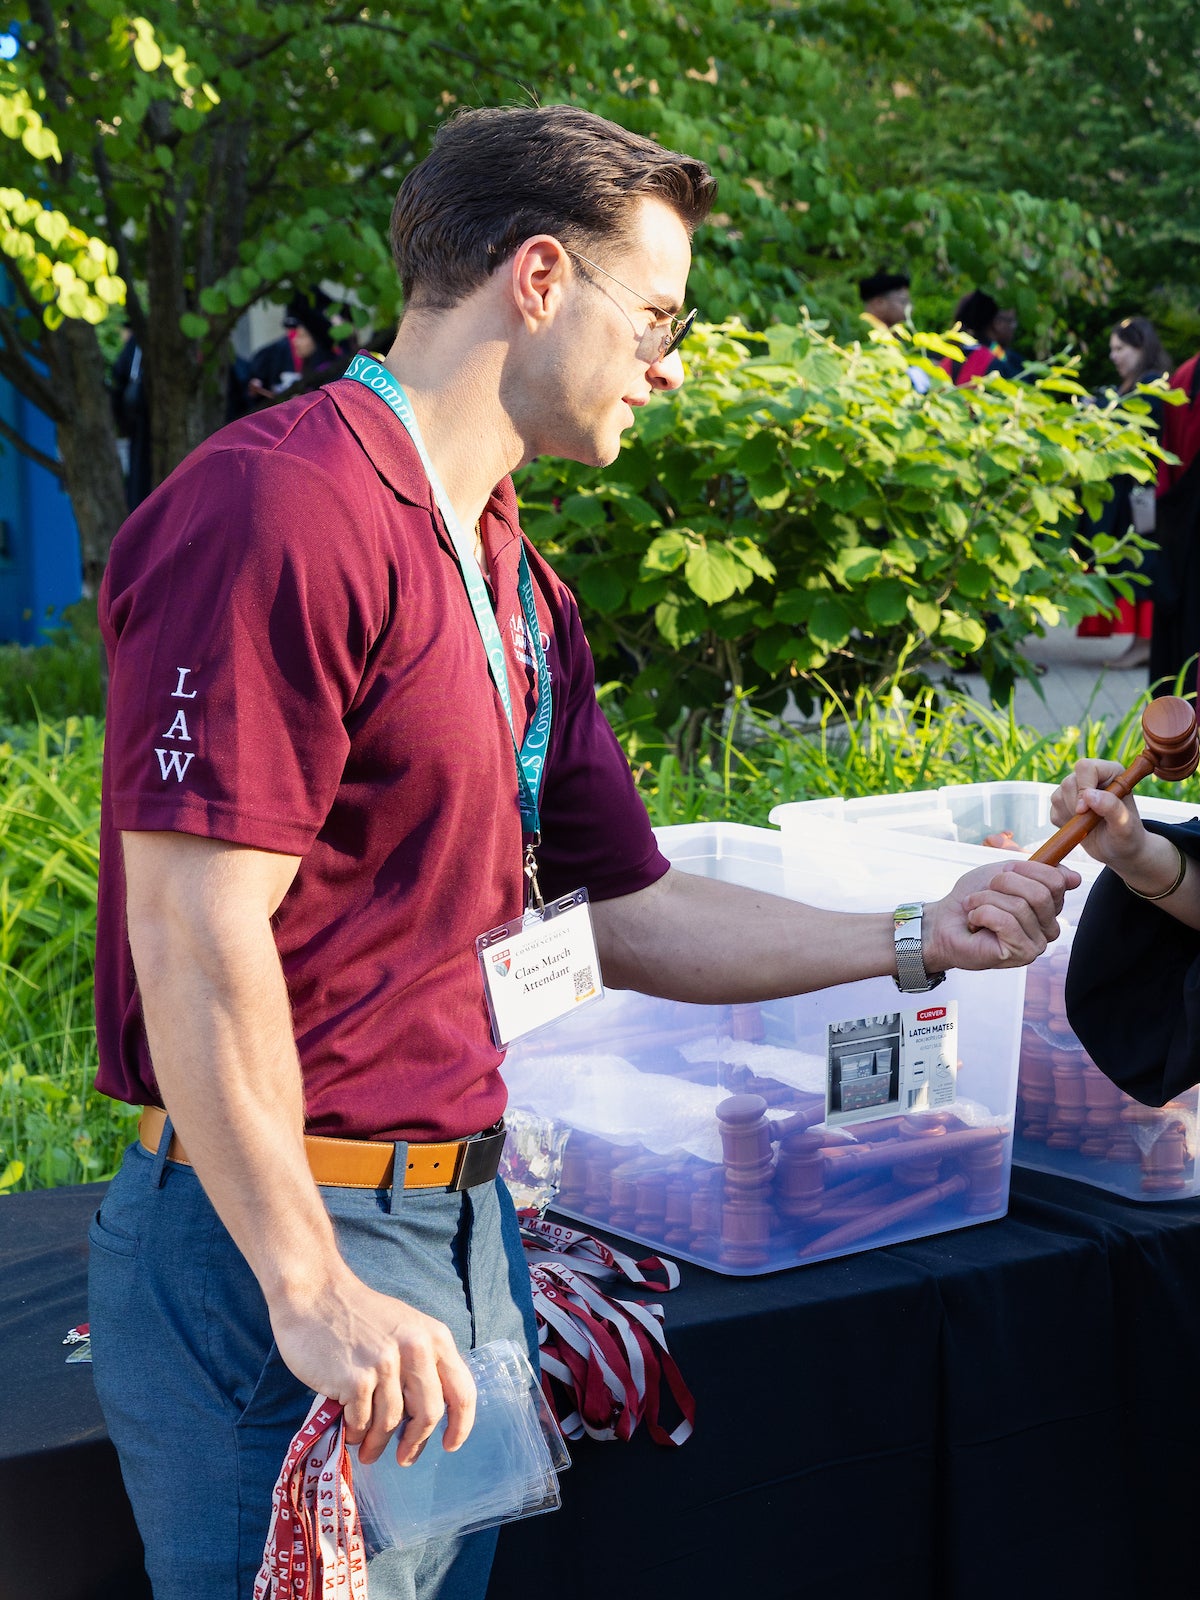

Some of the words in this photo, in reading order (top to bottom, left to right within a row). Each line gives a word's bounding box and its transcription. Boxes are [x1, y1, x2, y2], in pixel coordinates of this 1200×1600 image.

[469, 585, 497, 642] HLS
[154, 666, 198, 783] LAW
[514, 964, 540, 980] Class
[541, 947, 571, 968] March
[523, 966, 570, 994] Attendant
[909, 1026, 931, 1037] LATCH
[932, 1022, 954, 1033] MATES
[920, 1010, 944, 1019] CURVER
